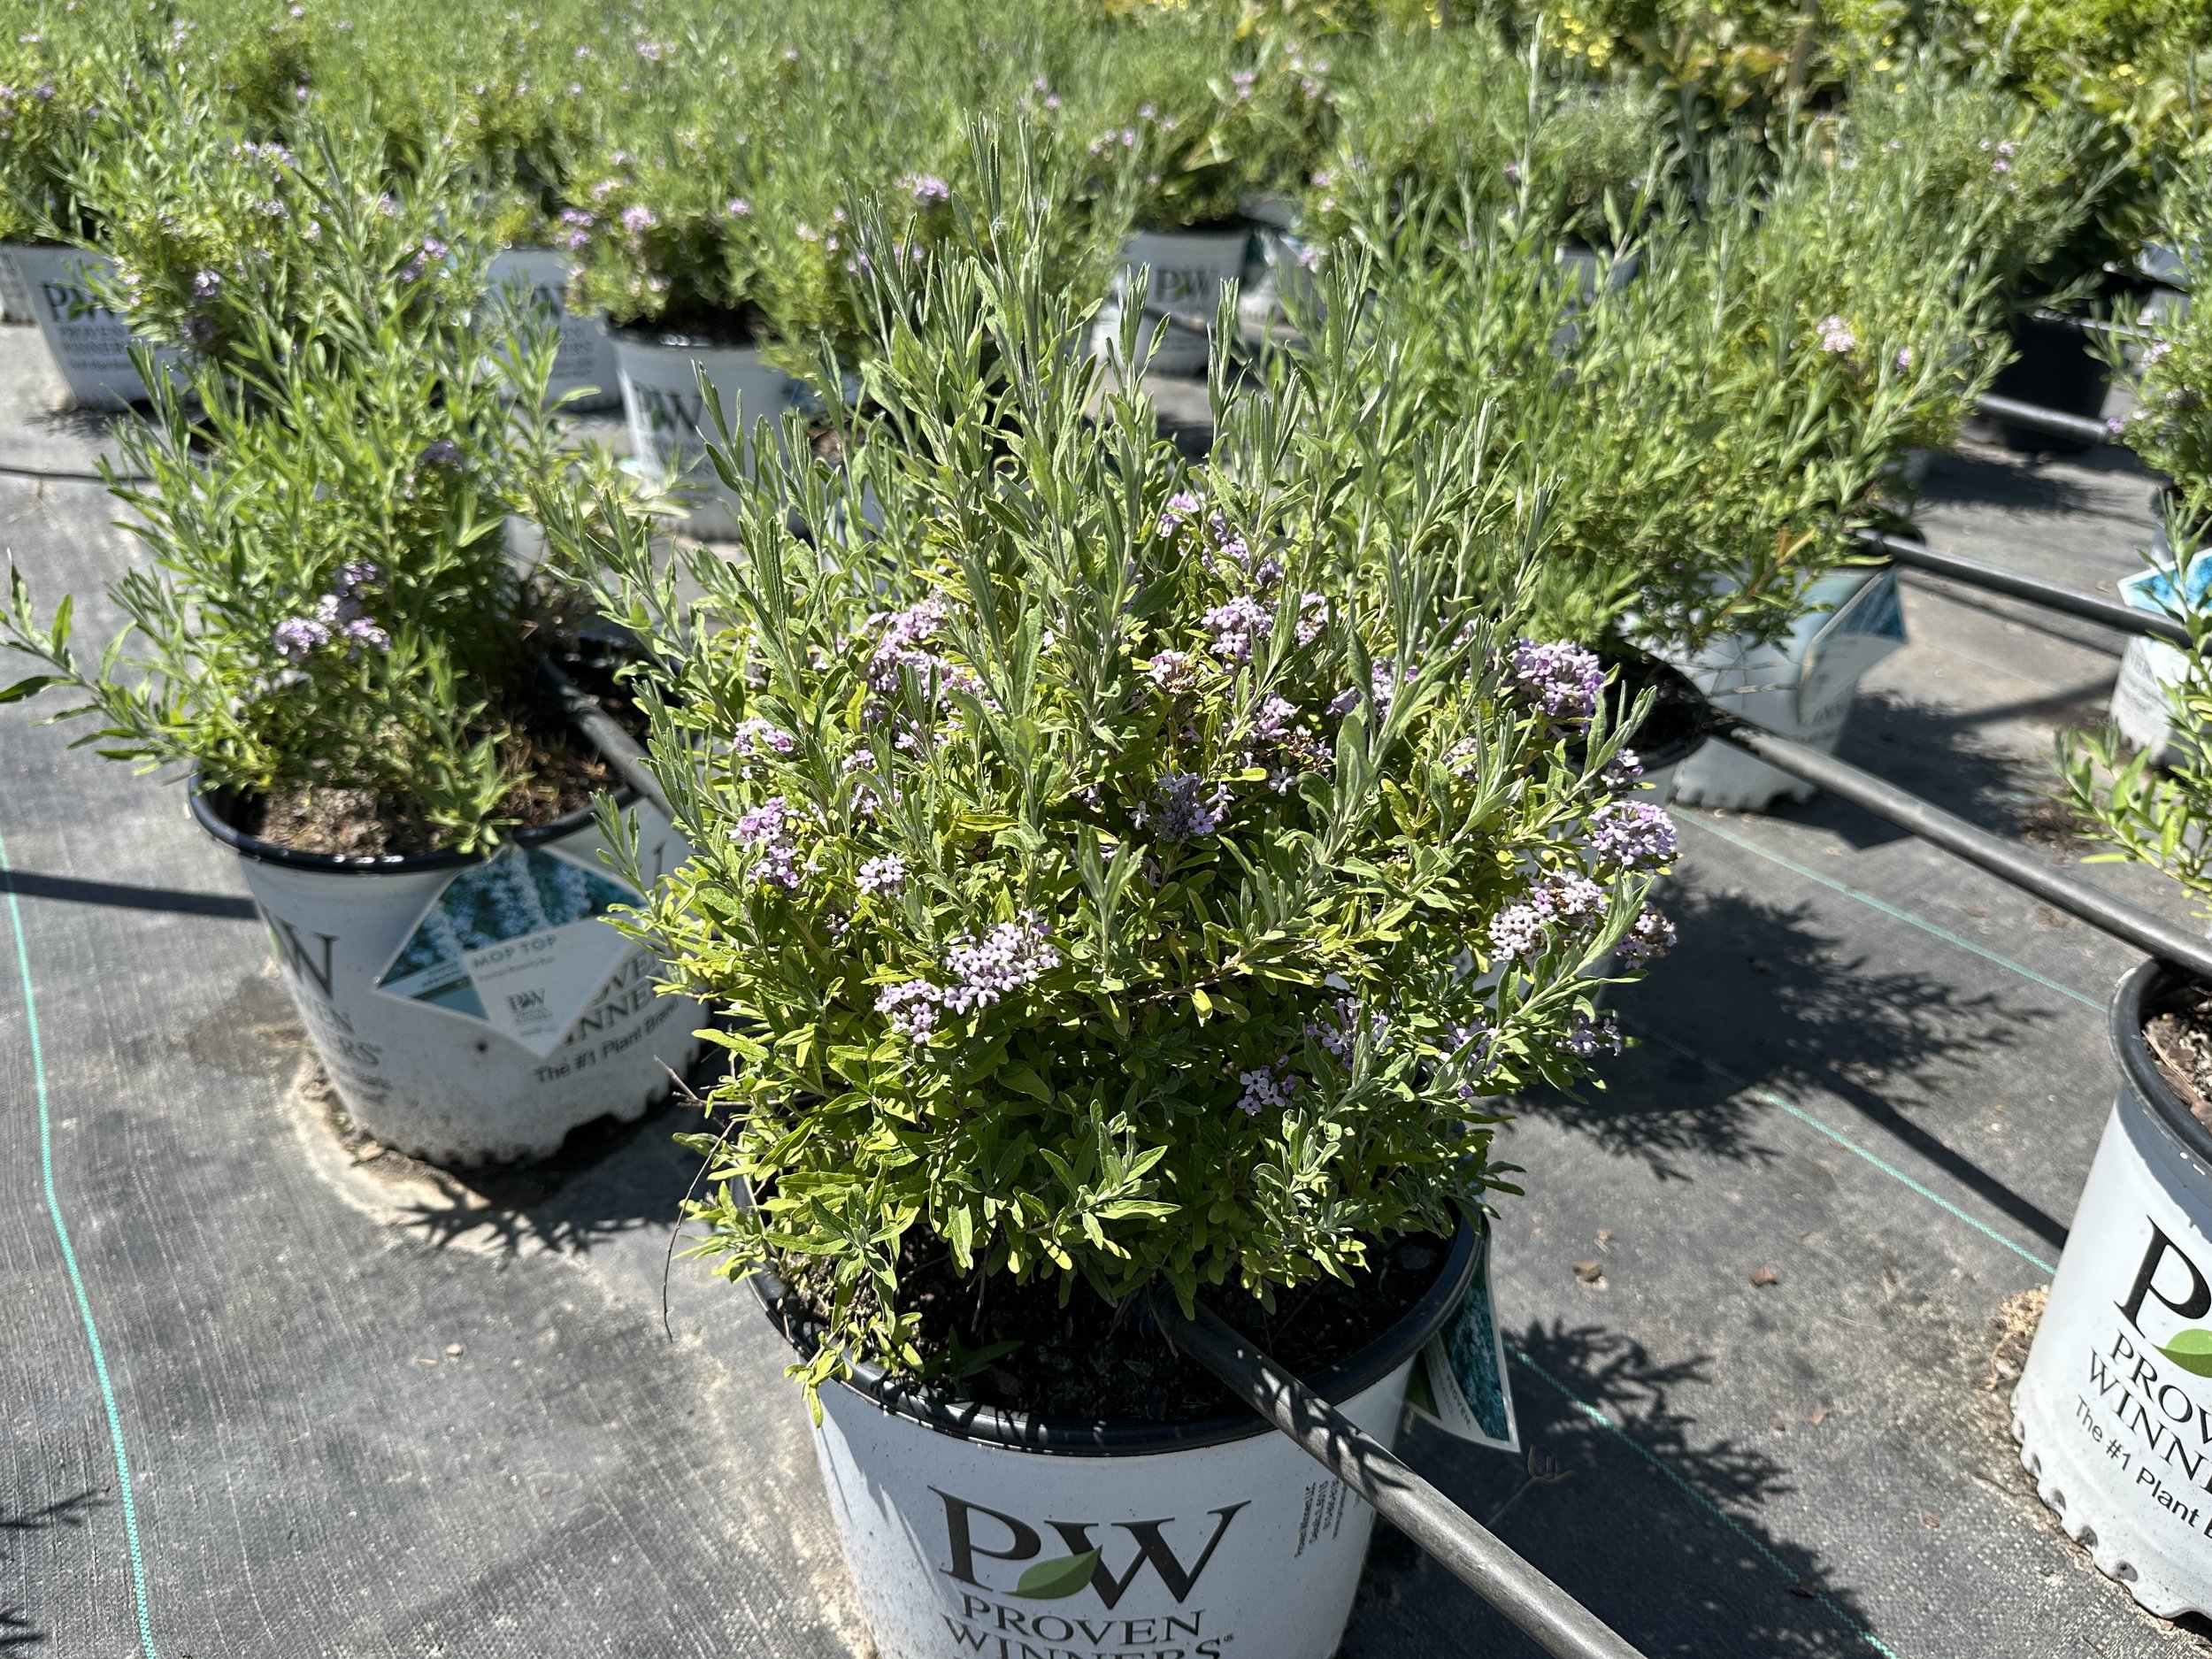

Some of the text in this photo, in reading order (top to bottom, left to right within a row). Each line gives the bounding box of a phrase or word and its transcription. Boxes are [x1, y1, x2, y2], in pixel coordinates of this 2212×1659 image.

[534, 996, 680, 1085] The #1 Plant Brand
[2076, 1394, 2200, 1528] The #1 Plant
[926, 1485, 1252, 1610] PW
[959, 1590, 1206, 1645] PROVEN
